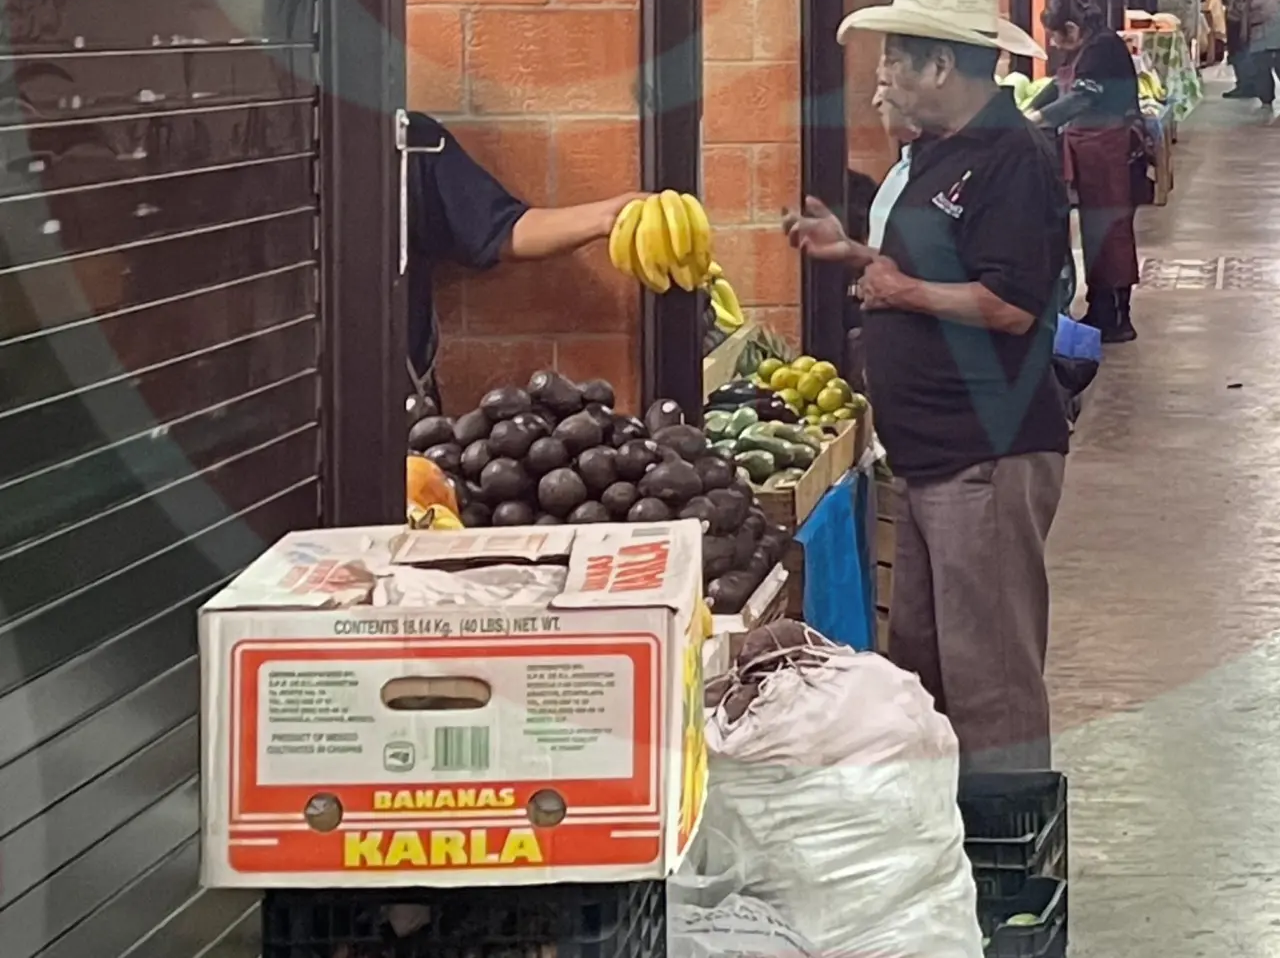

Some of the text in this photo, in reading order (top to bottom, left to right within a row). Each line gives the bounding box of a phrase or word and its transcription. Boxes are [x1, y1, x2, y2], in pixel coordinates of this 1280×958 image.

[334, 619, 398, 635] CONTENTS
[373, 788, 515, 809] BANANAS
[344, 828, 543, 867] KARLA
